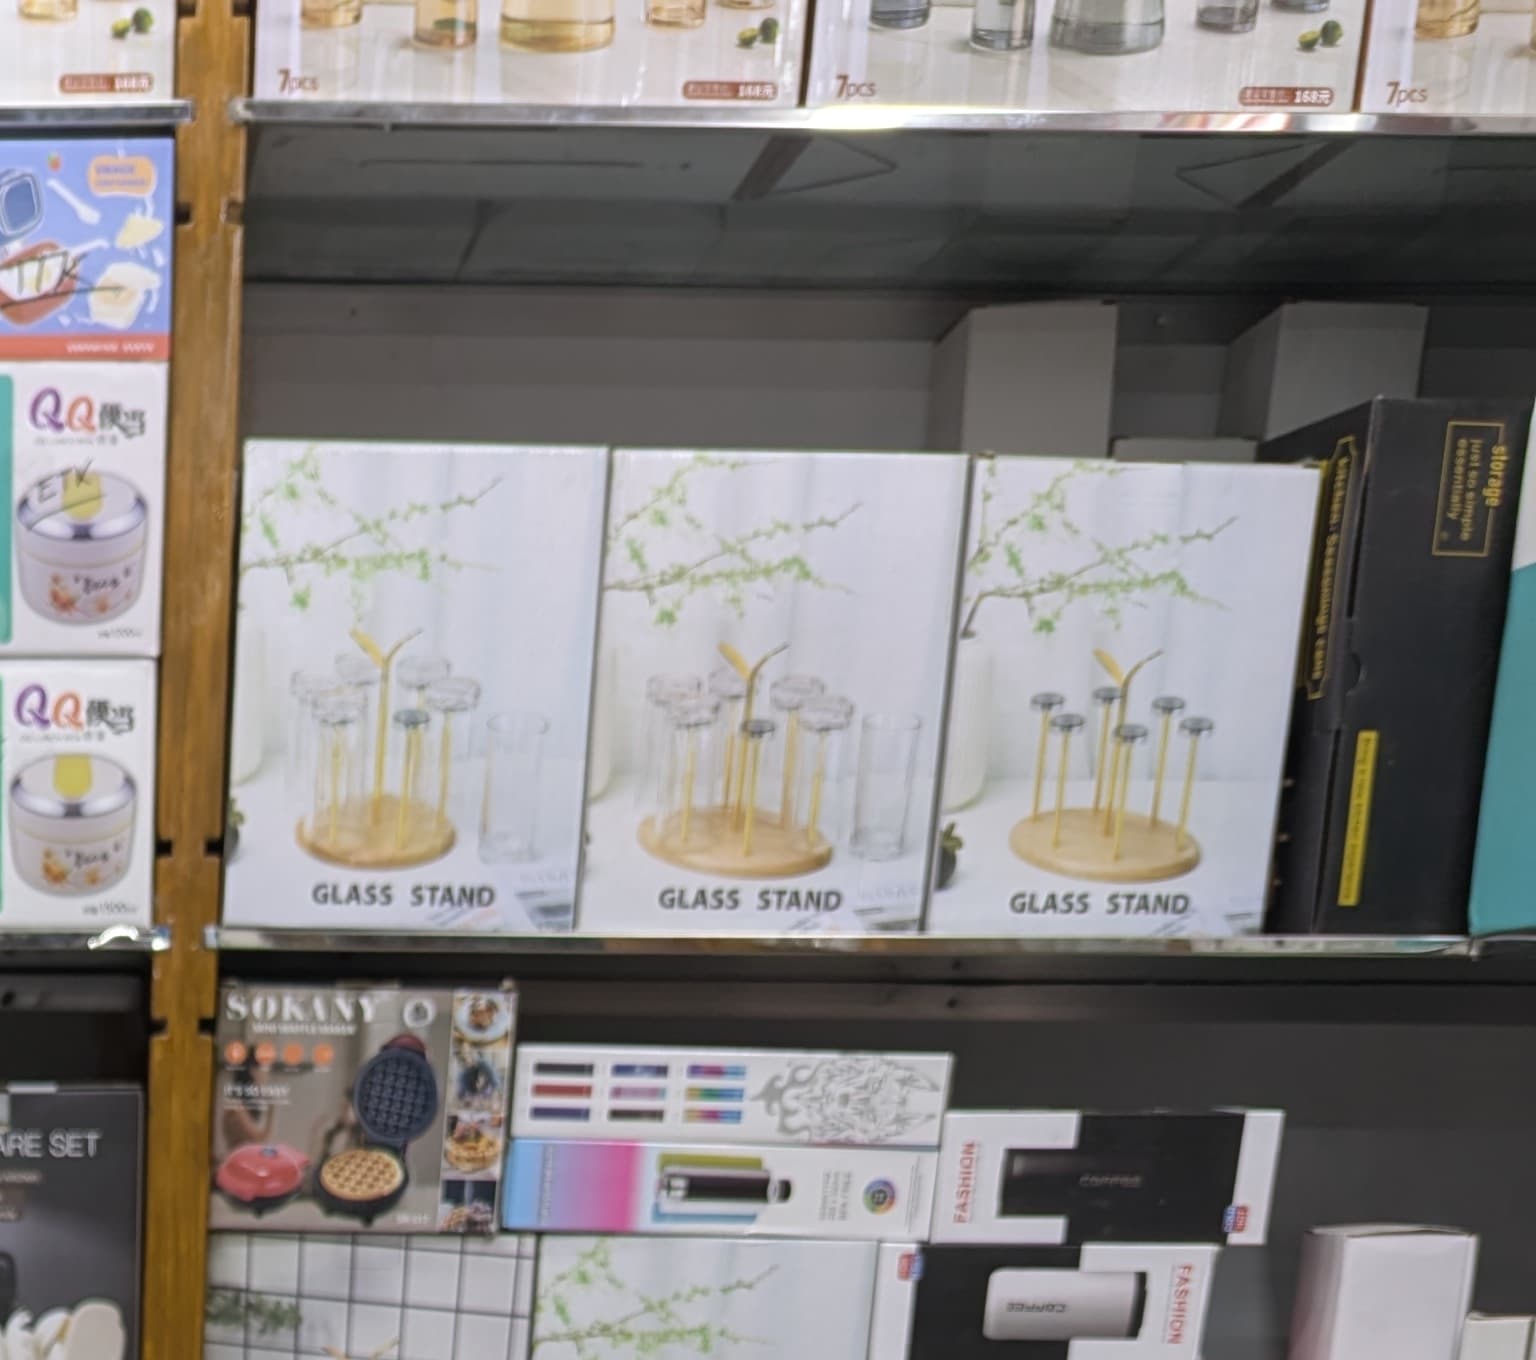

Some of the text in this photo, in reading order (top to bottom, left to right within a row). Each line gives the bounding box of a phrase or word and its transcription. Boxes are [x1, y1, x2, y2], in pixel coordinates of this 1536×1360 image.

[836, 74, 878, 101] 7pcs
[1385, 81, 1429, 108] 7pcs
[1482, 445, 1509, 508] storage
[312, 884, 496, 909] GLASS STAND
[658, 888, 844, 913] GLASS STAND
[1008, 892, 1191, 916] GLASS STAND
[49, 1130, 103, 1159] SET
[953, 1141, 976, 1224] FASHION
[1167, 1263, 1195, 1345] FASHION
